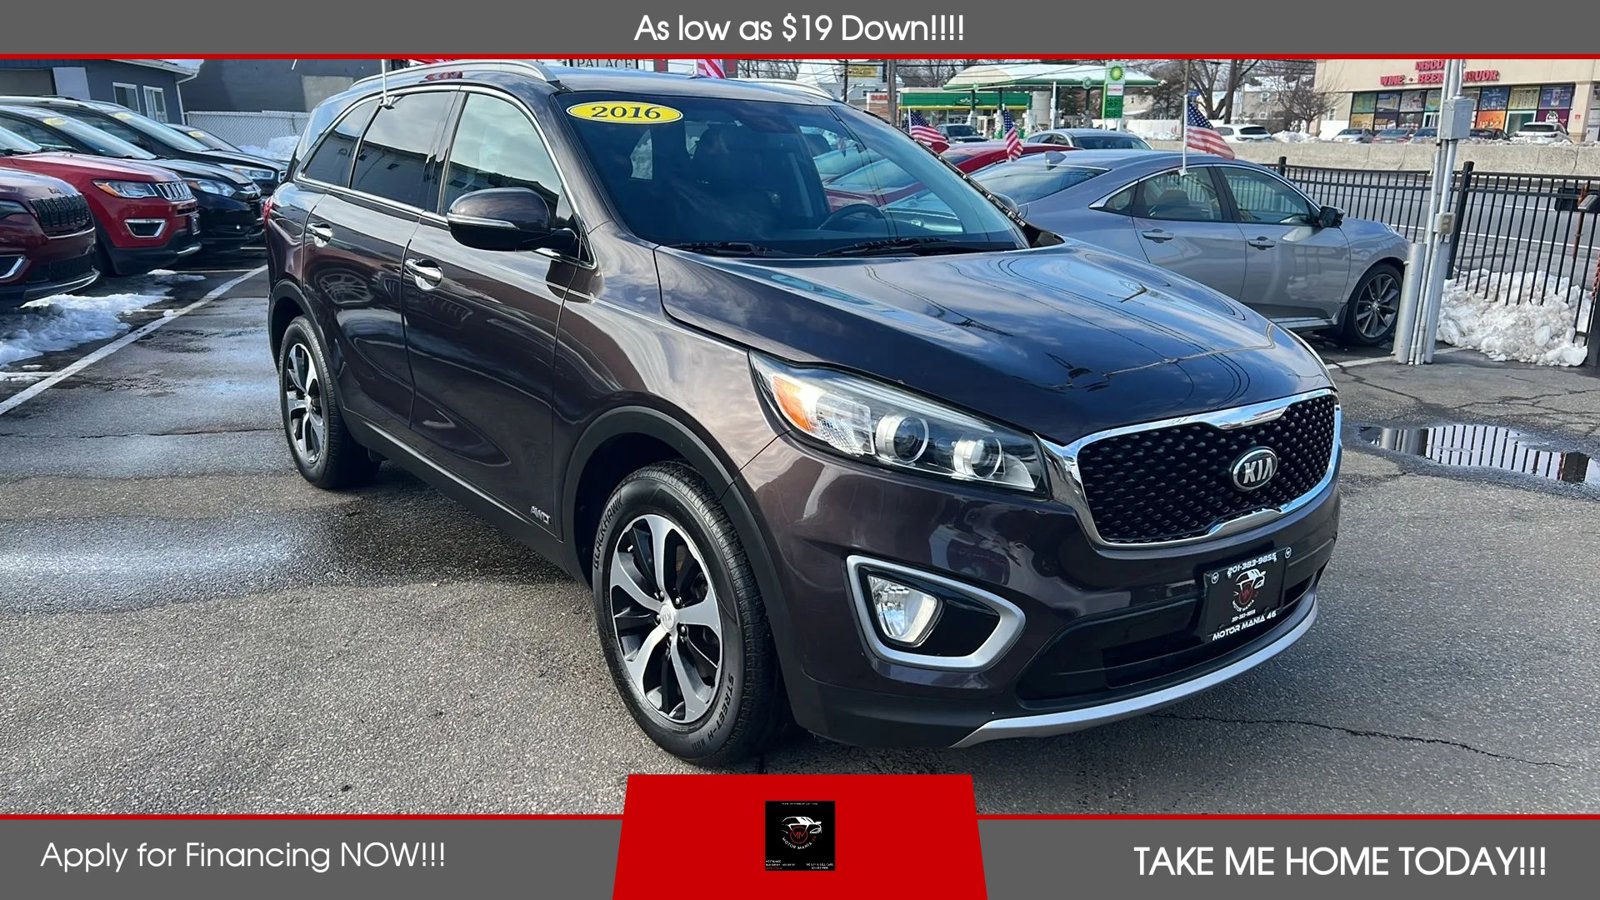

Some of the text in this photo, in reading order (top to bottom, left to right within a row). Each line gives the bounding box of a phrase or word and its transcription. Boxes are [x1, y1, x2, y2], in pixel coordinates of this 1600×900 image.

[1463, 70, 1500, 82] IQUOR
[591, 105, 661, 119] 2016
[1243, 457, 1273, 484] KIA
[1212, 624, 1241, 641] MOTOR
[1241, 614, 1266, 630] MANIA
[1266, 610, 1277, 619] 46
